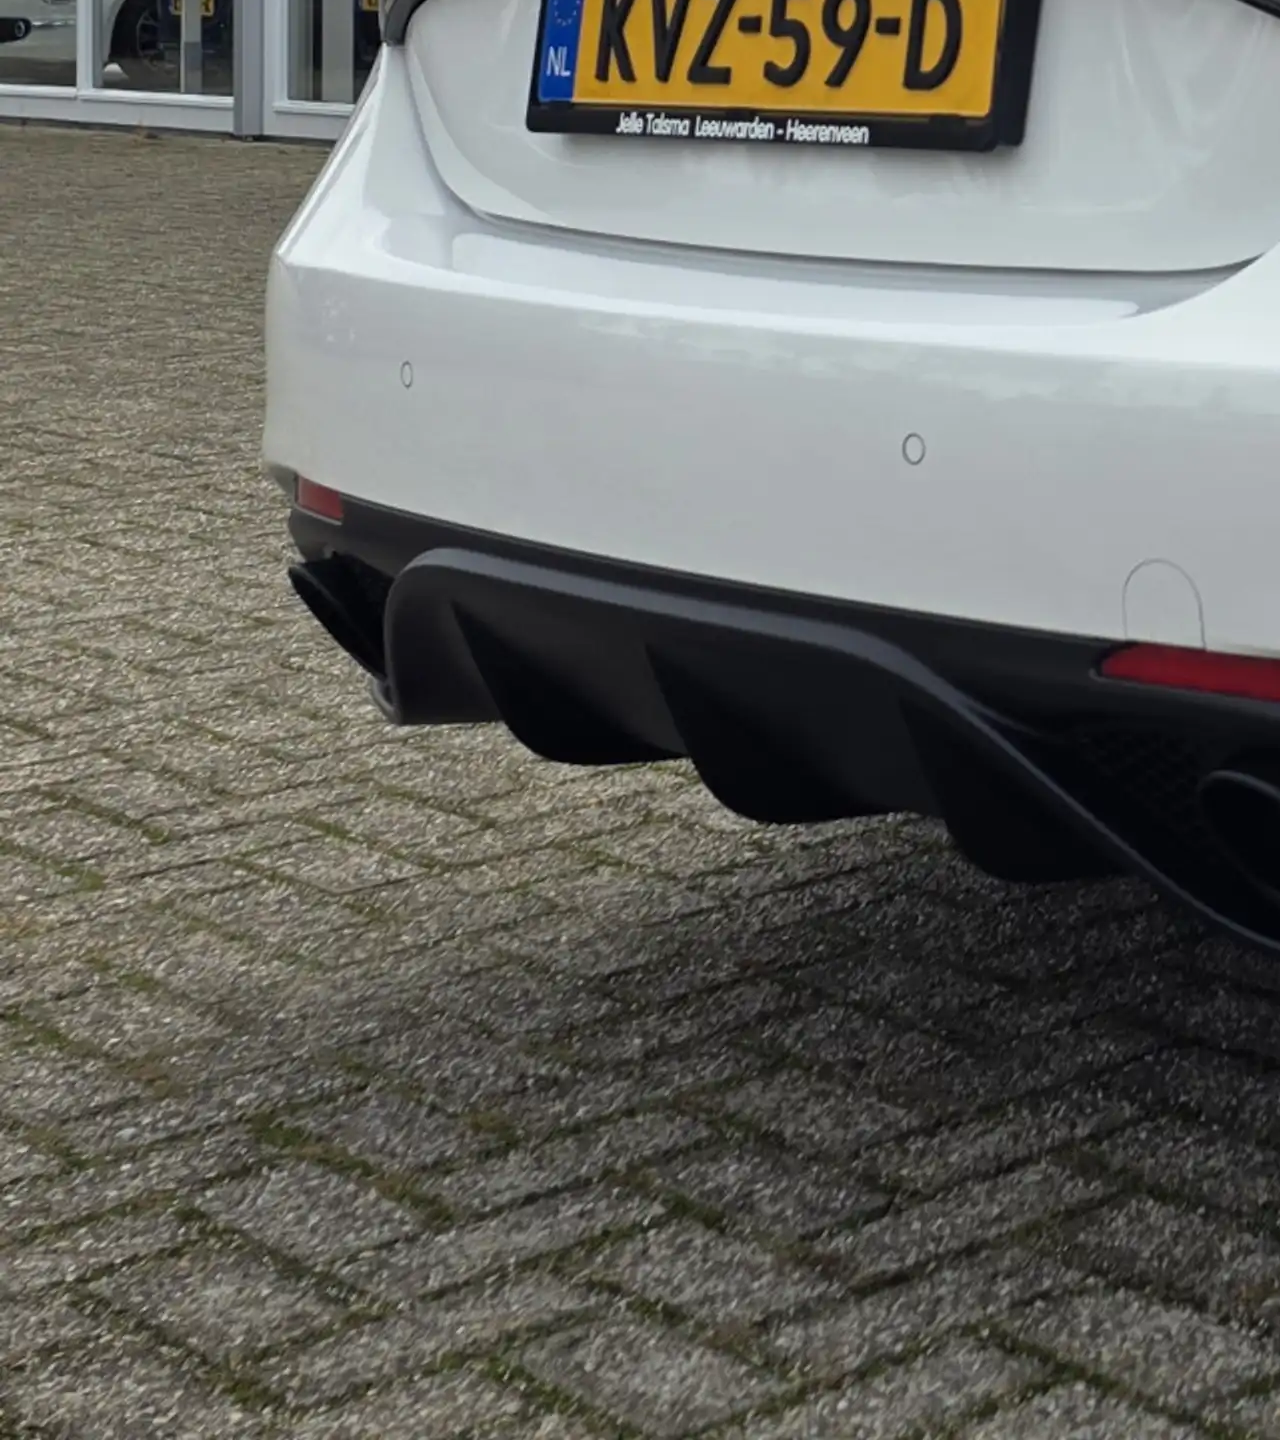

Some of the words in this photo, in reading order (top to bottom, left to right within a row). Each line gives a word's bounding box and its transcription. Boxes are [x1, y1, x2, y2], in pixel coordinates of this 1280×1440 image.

[546, 45, 572, 78] NL
[615, 111, 644, 134] Jelle
[645, 113, 691, 137] Talsma
[694, 115, 775, 141] Leeuwarden
[785, 118, 870, 145] Heerenveen
